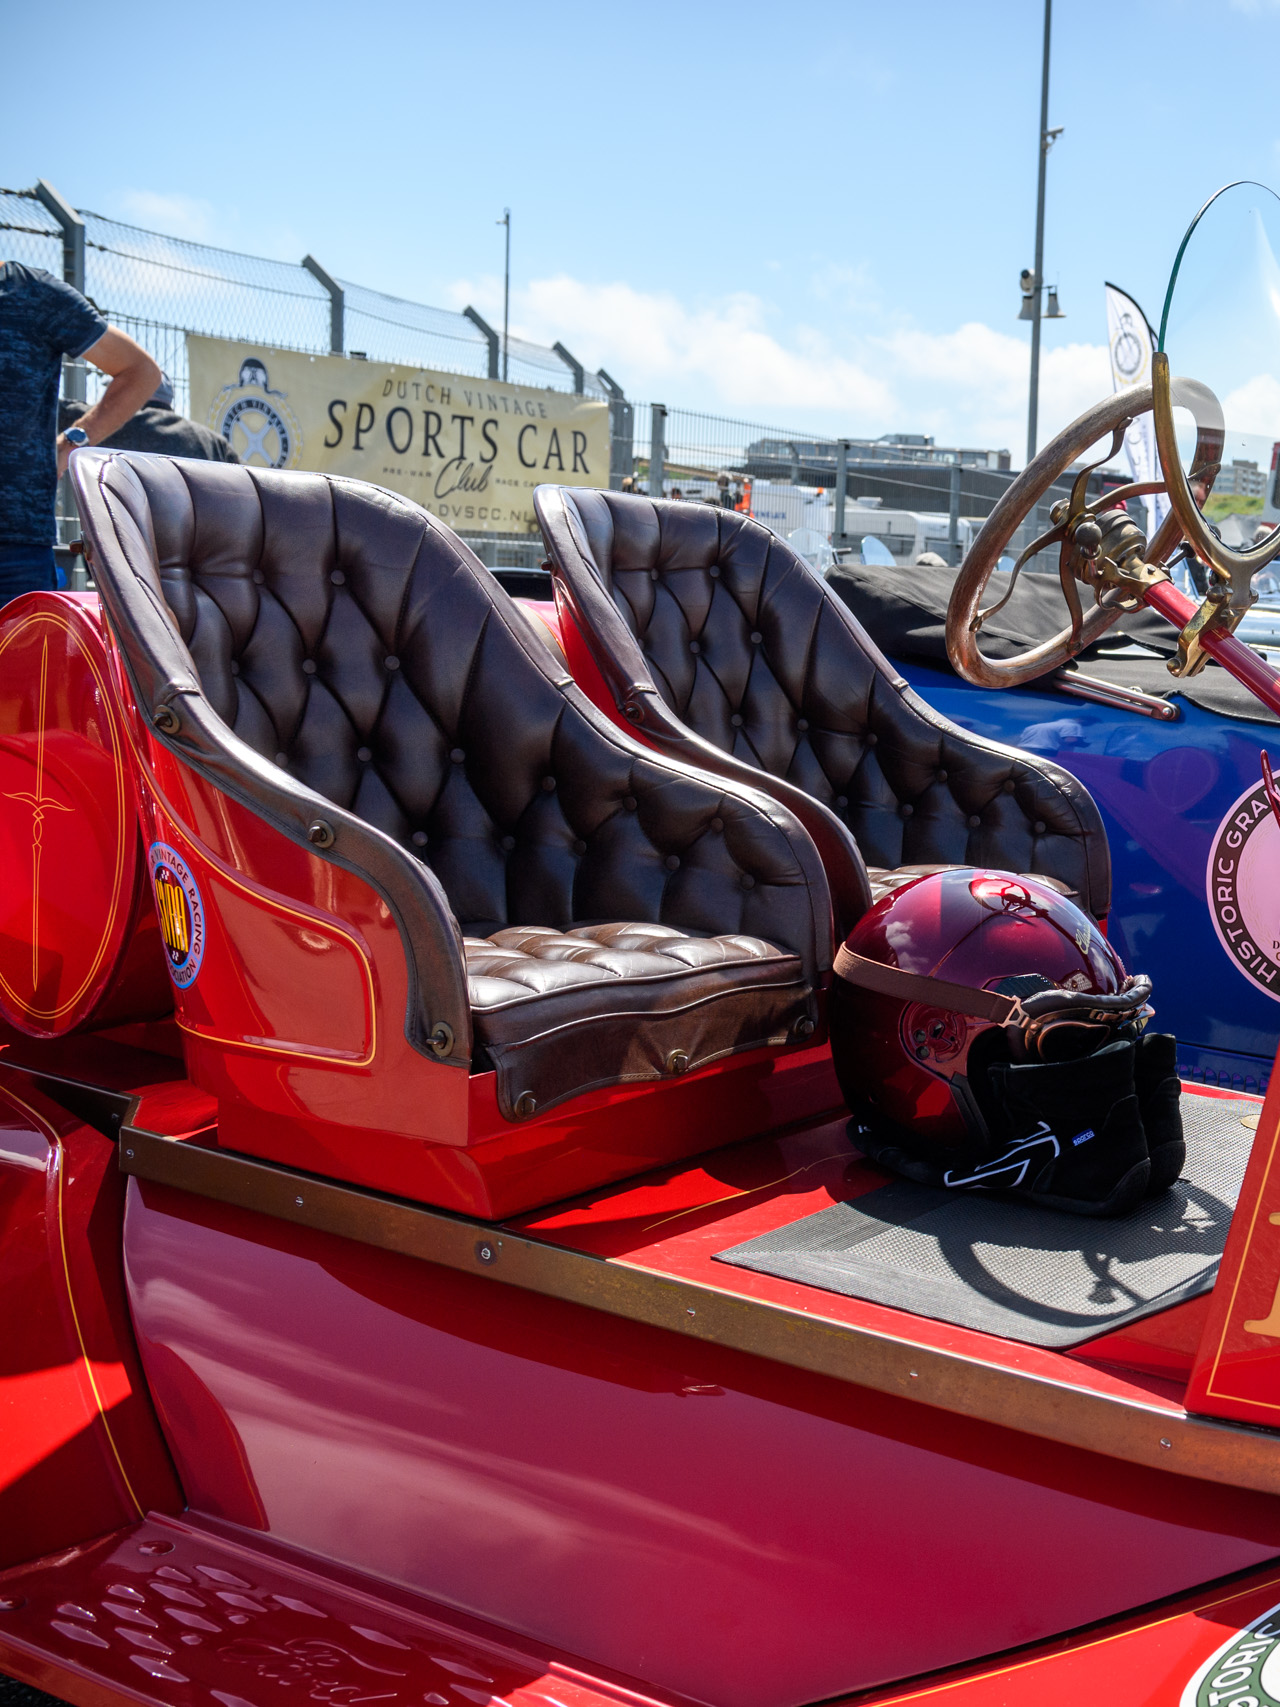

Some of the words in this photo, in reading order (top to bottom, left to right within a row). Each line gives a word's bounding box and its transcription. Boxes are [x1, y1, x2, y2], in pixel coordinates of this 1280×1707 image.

[382, 378, 452, 406] DUTCH
[464, 389, 548, 419] VINTAGE
[324, 399, 498, 464] SPORTS
[517, 423, 591, 474] CAR
[433, 456, 493, 499] Club
[495, 478, 519, 487] RACE
[155, 848, 189, 884] VINTAGE
[188, 887, 202, 956] RACING
[1217, 857, 1277, 983] HISTORIC
[1073, 1130, 1095, 1146] sparco
